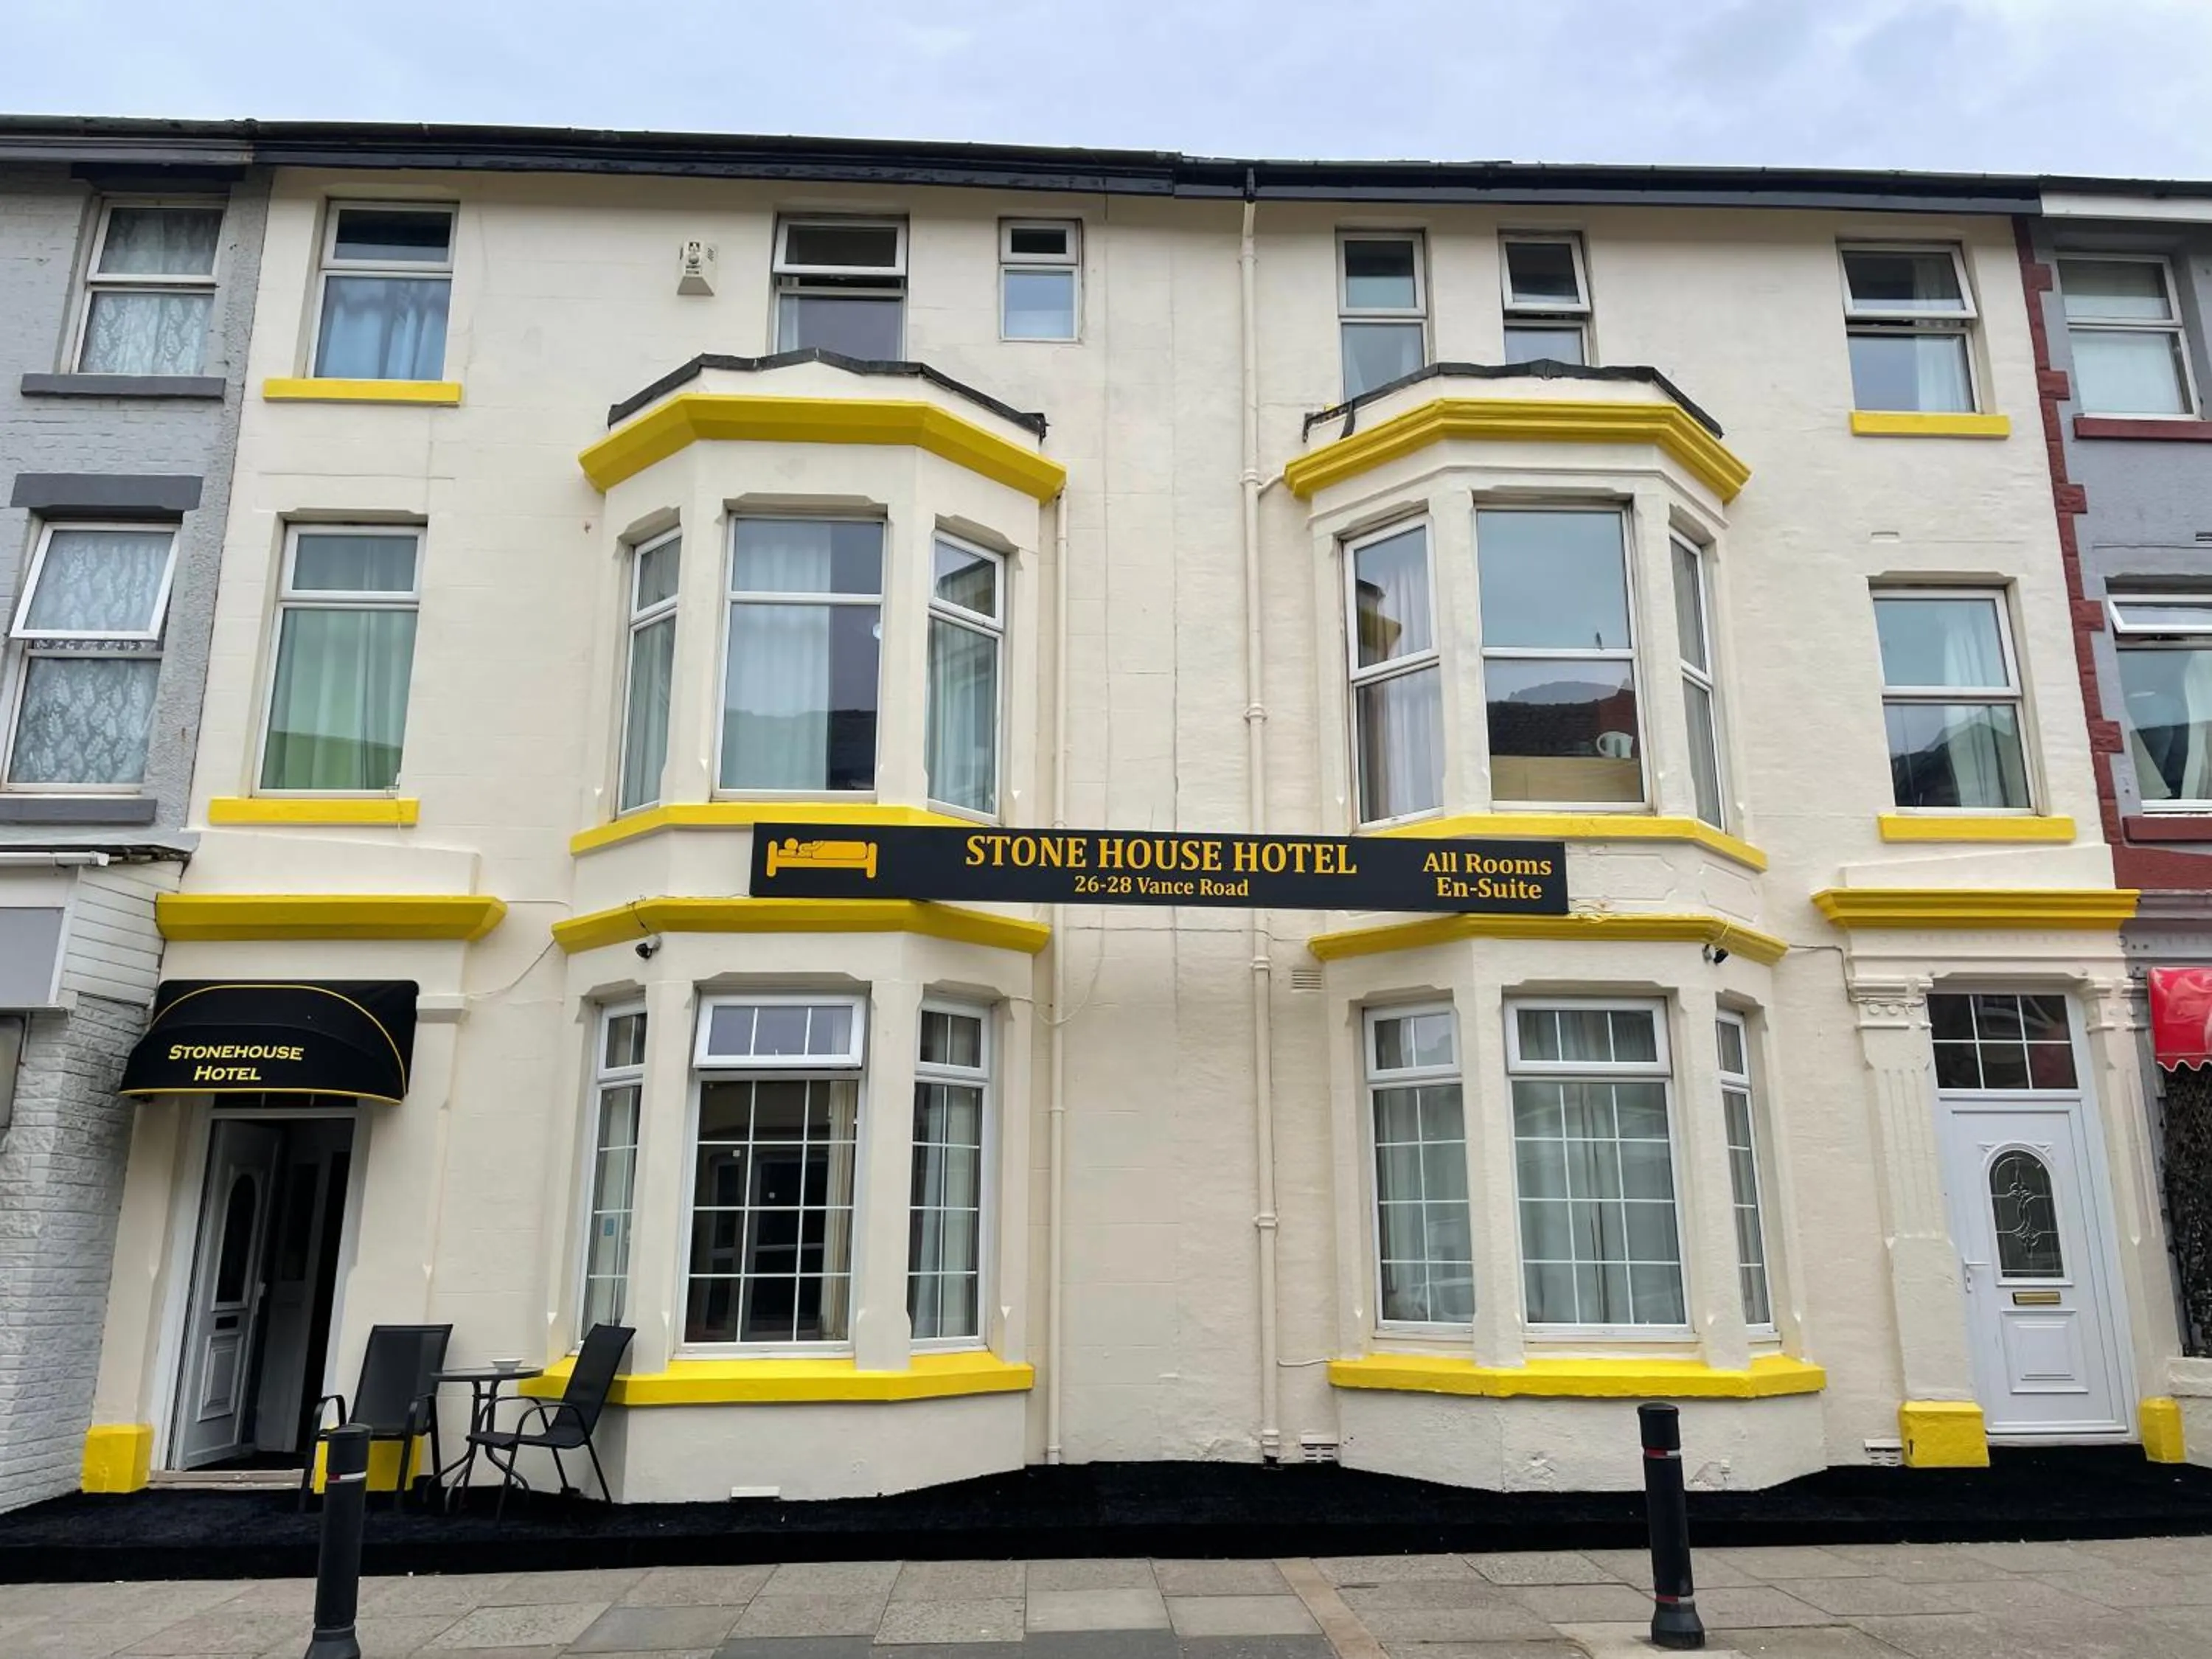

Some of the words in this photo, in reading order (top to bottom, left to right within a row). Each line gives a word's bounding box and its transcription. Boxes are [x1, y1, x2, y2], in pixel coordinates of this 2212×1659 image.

[966, 835, 1087, 867] STONE
[1099, 839, 1222, 872] HOUSE
[1234, 843, 1357, 874] HOTEL
[1423, 852, 1458, 872] All
[1465, 853, 1552, 874] Rooms
[1075, 876, 1132, 894] 26-28
[1137, 877, 1193, 895] Vance
[1200, 879, 1248, 897] Road
[1437, 877, 1541, 899] En-Suite
